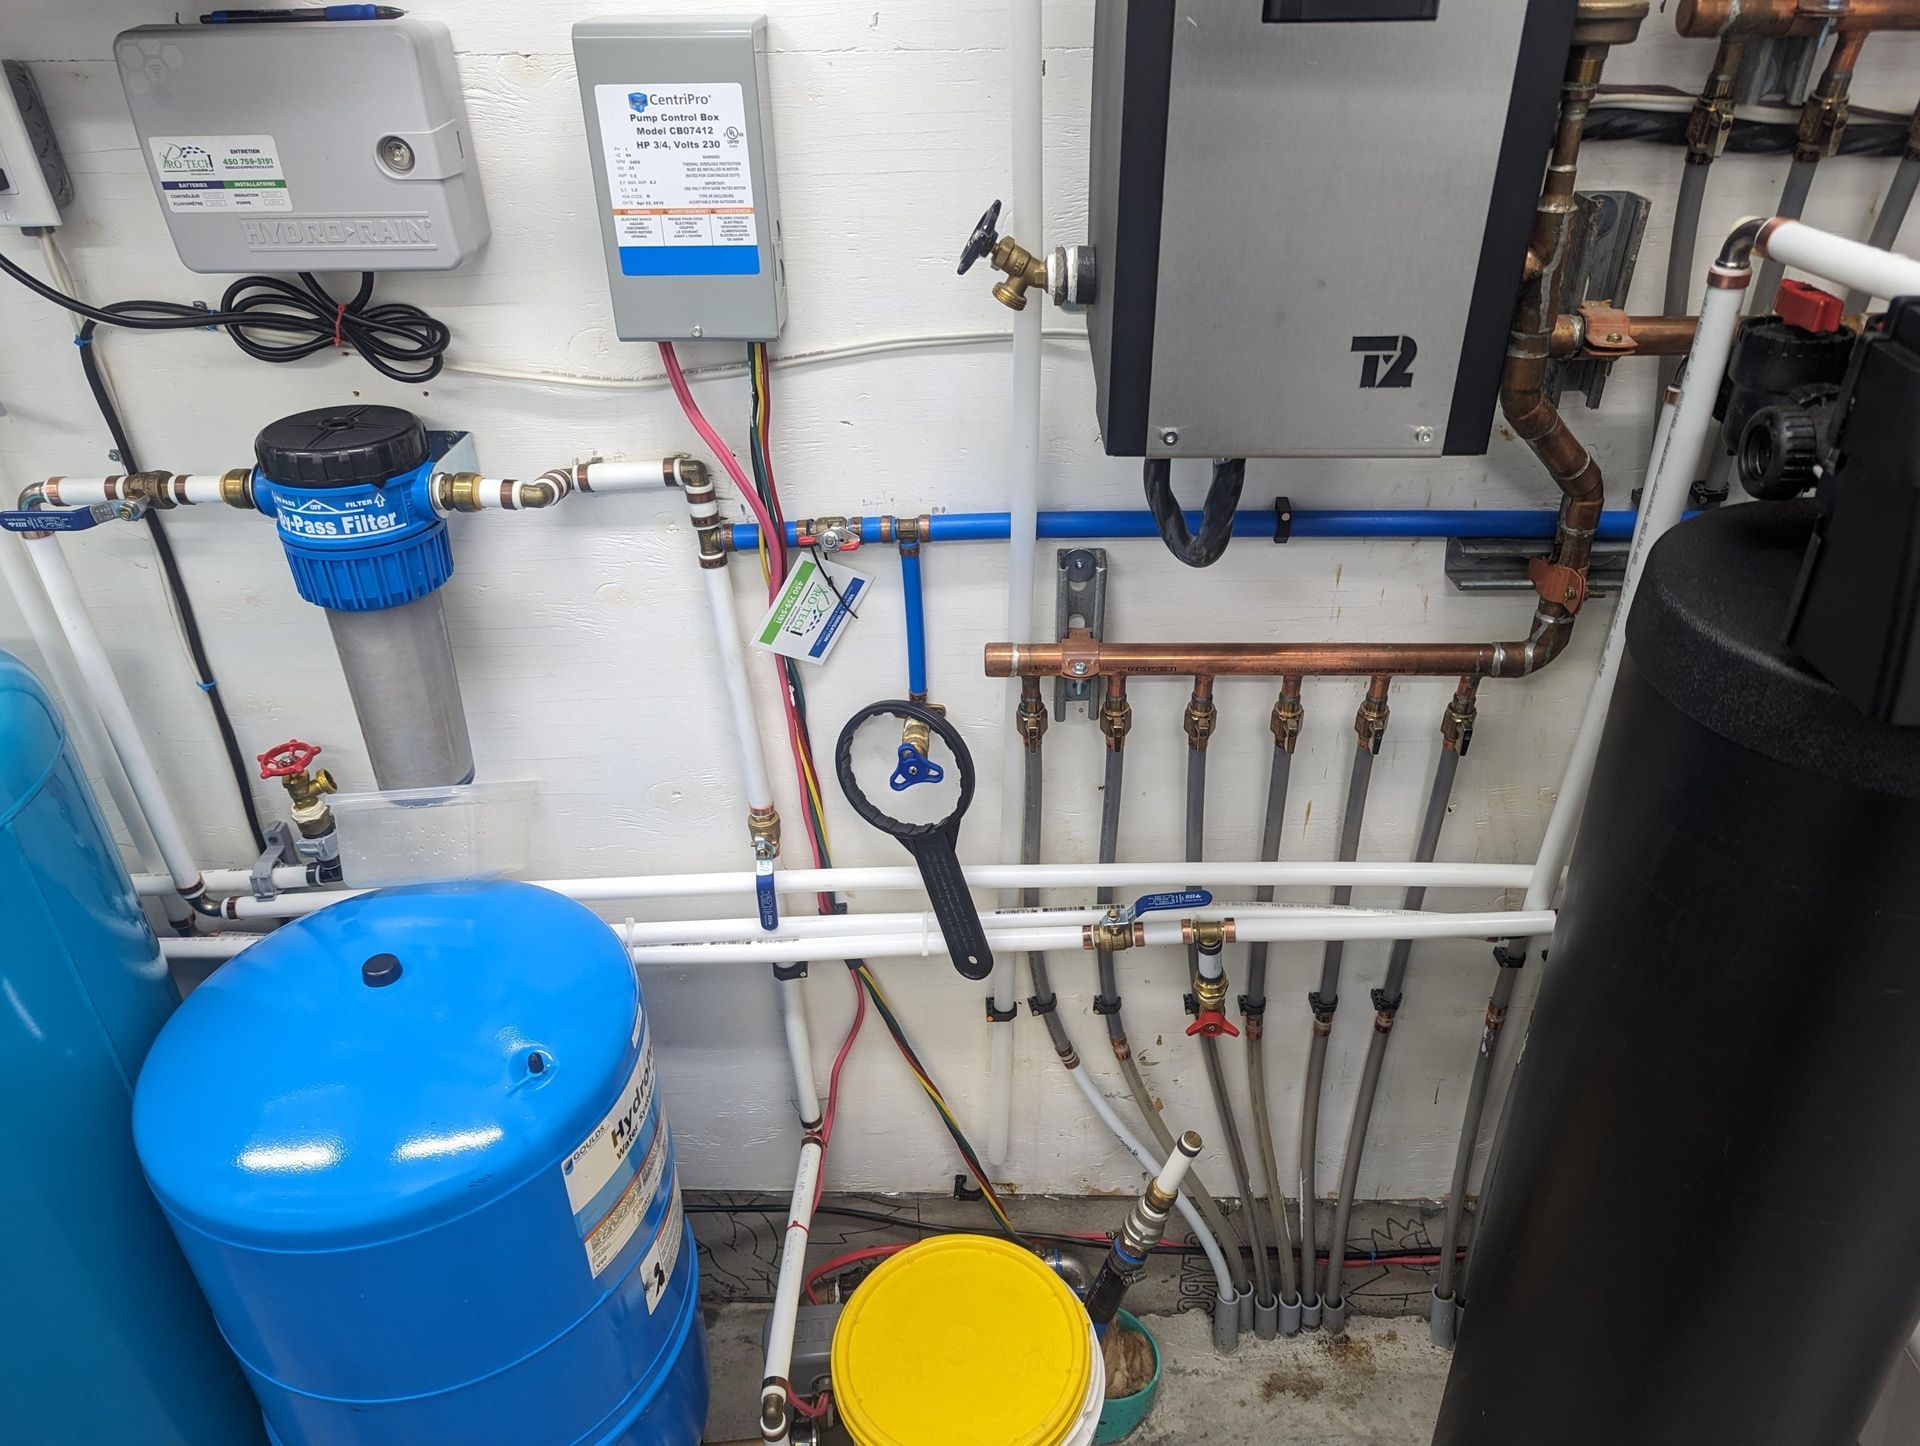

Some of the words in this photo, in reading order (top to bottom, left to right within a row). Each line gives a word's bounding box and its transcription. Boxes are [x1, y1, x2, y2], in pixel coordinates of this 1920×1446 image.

[649, 92, 709, 106] CentriPro
[629, 113, 658, 124] Pump
[660, 113, 697, 122] Control
[700, 113, 720, 121] Box
[636, 127, 667, 136] Model
[669, 126, 714, 136] CB07412
[636, 141, 650, 149] HP
[673, 140, 700, 149] Volts
[702, 140, 721, 149] 230
[223, 158, 238, 166] 450
[240, 157, 273, 166] 759-5191
[234, 180, 277, 188] INSTALLATIONS
[1351, 335, 1418, 388] T2
[345, 499, 373, 509] FILTER
[277, 507, 337, 536] By-Pass
[341, 511, 397, 535] Filter
[792, 580, 804, 596] 450
[776, 594, 798, 625] 759-5191
[573, 1124, 606, 1161] GOULDS
[616, 1123, 639, 1161] Water
